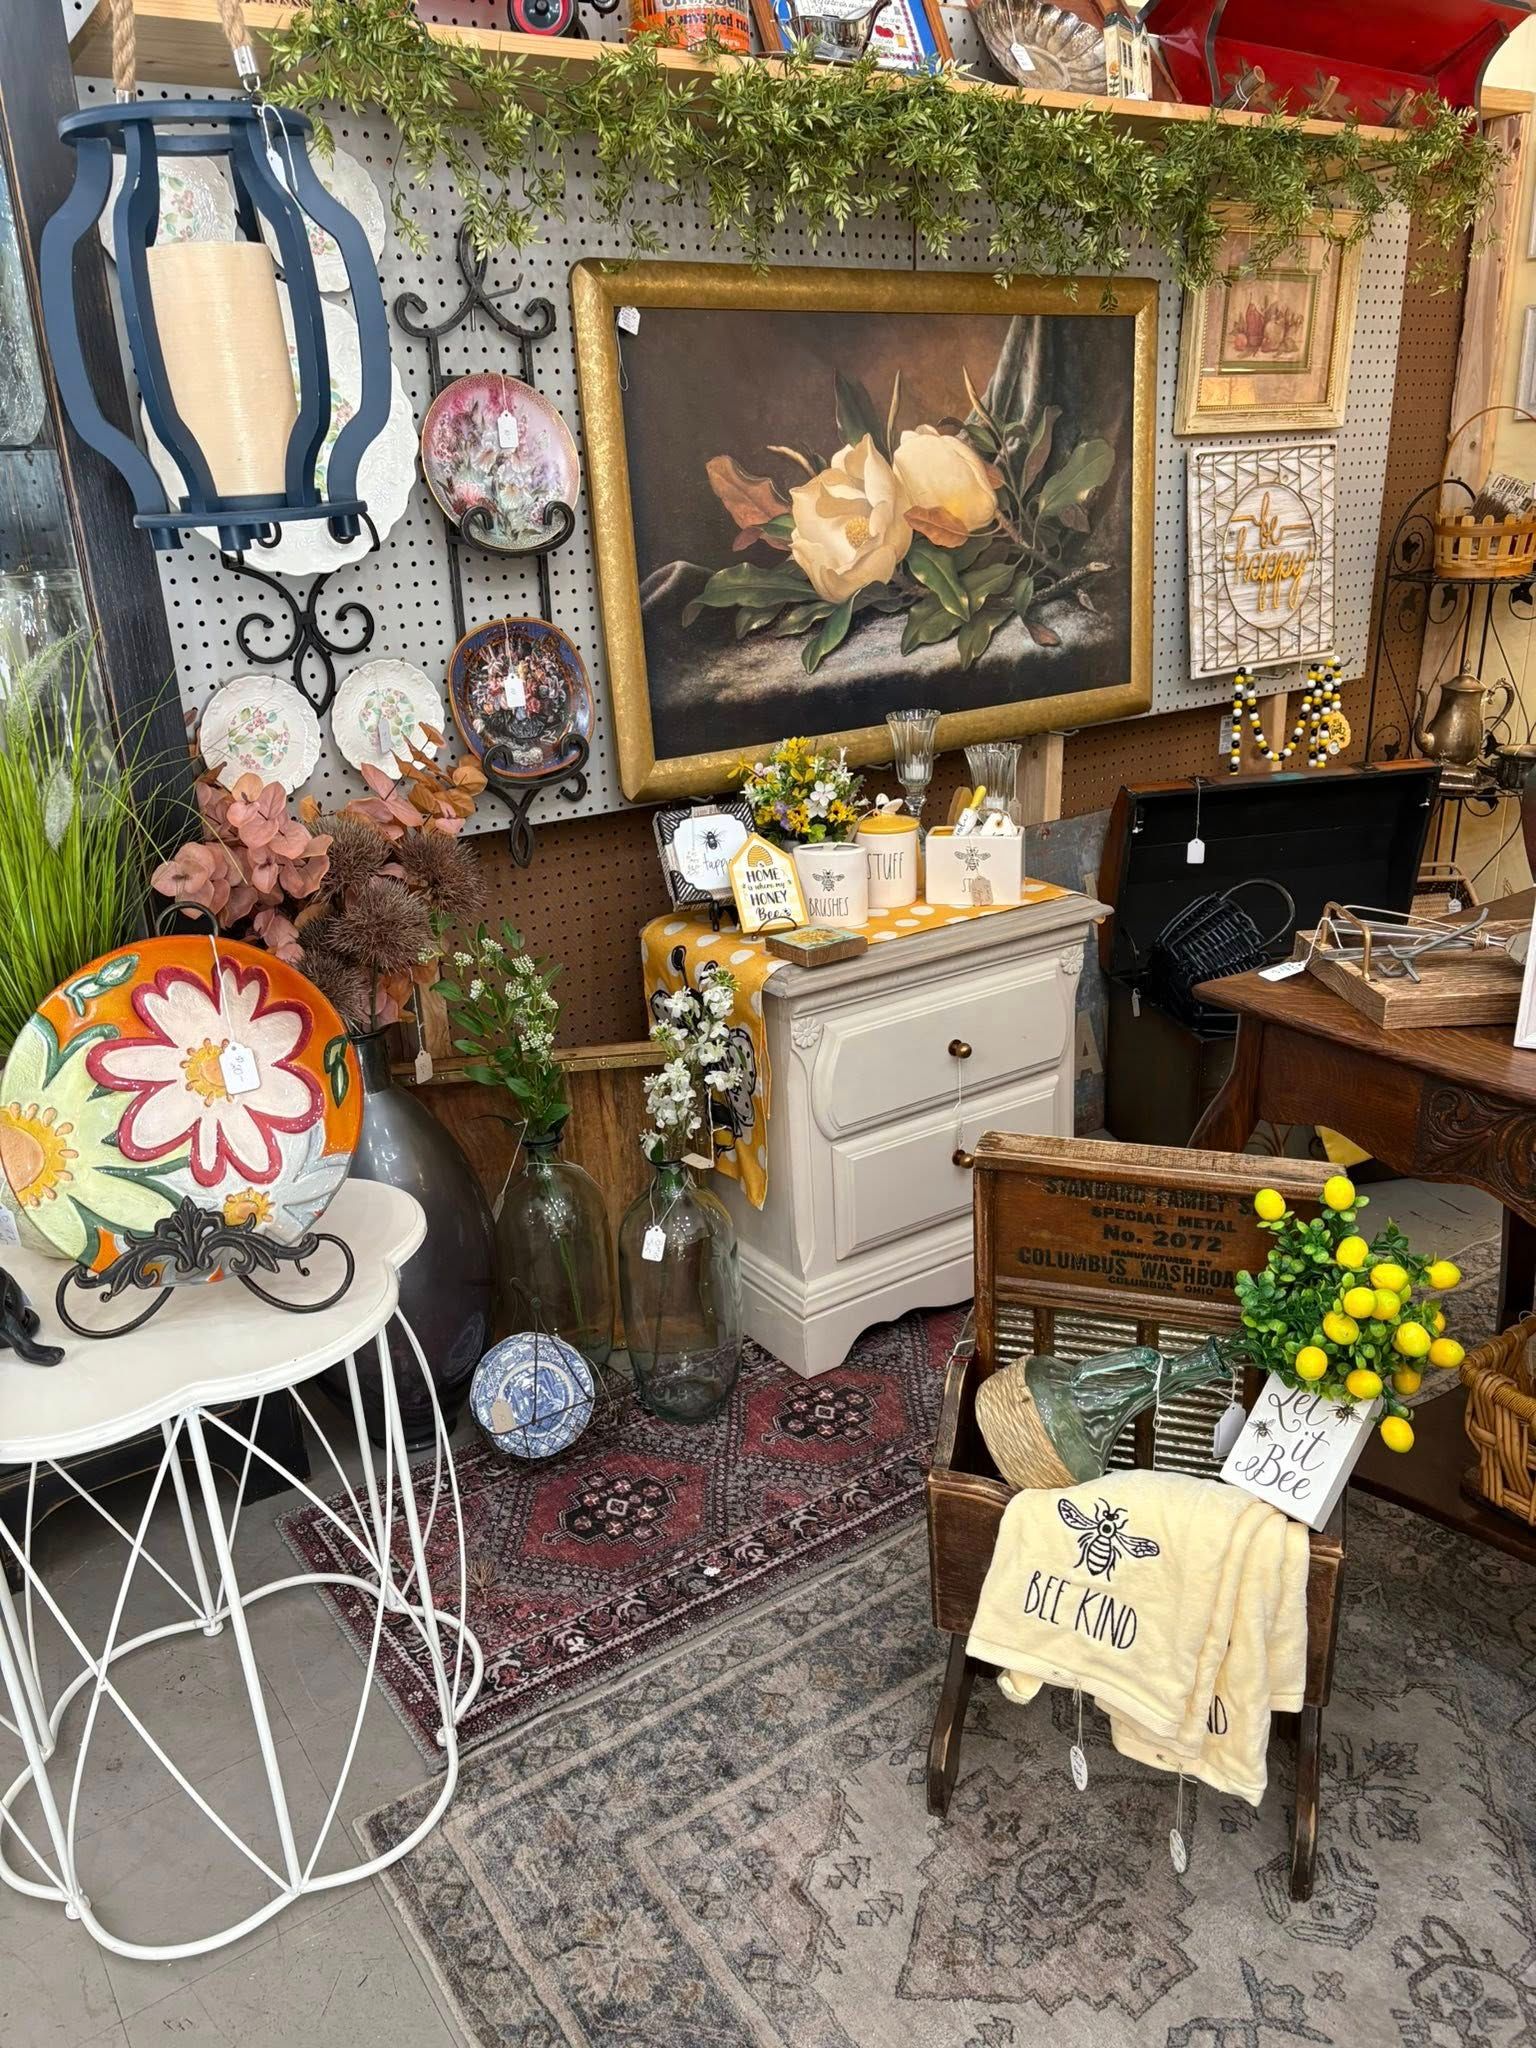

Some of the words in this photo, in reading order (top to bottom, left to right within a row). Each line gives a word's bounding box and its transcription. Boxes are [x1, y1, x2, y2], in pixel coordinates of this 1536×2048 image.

[668, 12, 733, 26] cnveted
[1223, 526, 1314, 612] happy
[746, 868, 781, 883] HOME
[866, 851, 905, 881] STUFF
[750, 889, 788, 906] HONEY
[775, 882, 785, 890] my
[755, 907, 780, 921] Bee
[808, 896, 849, 917] BRUSHES
[1042, 1177, 1146, 1204] STANDARD
[1156, 1186, 1226, 1213] FAMILY
[1090, 1206, 1168, 1225] SPECIAL
[1177, 1216, 1237, 1232] METAL
[1103, 1224, 1143, 1244] No.
[1152, 1230, 1222, 1252] 2072
[1017, 1246, 1126, 1277] COLUMBUS
[1110, 1249, 1193, 1265] MANUFACTURED
[1197, 1259, 1213, 1267] BY
[1184, 1285, 1214, 1296] OHIO
[1268, 1387, 1329, 1433] Let
[1291, 1431, 1331, 1471] it
[1235, 1443, 1312, 1500] Bee
[1024, 1571, 1071, 1625] BEE
[1075, 1588, 1137, 1650] KIND
